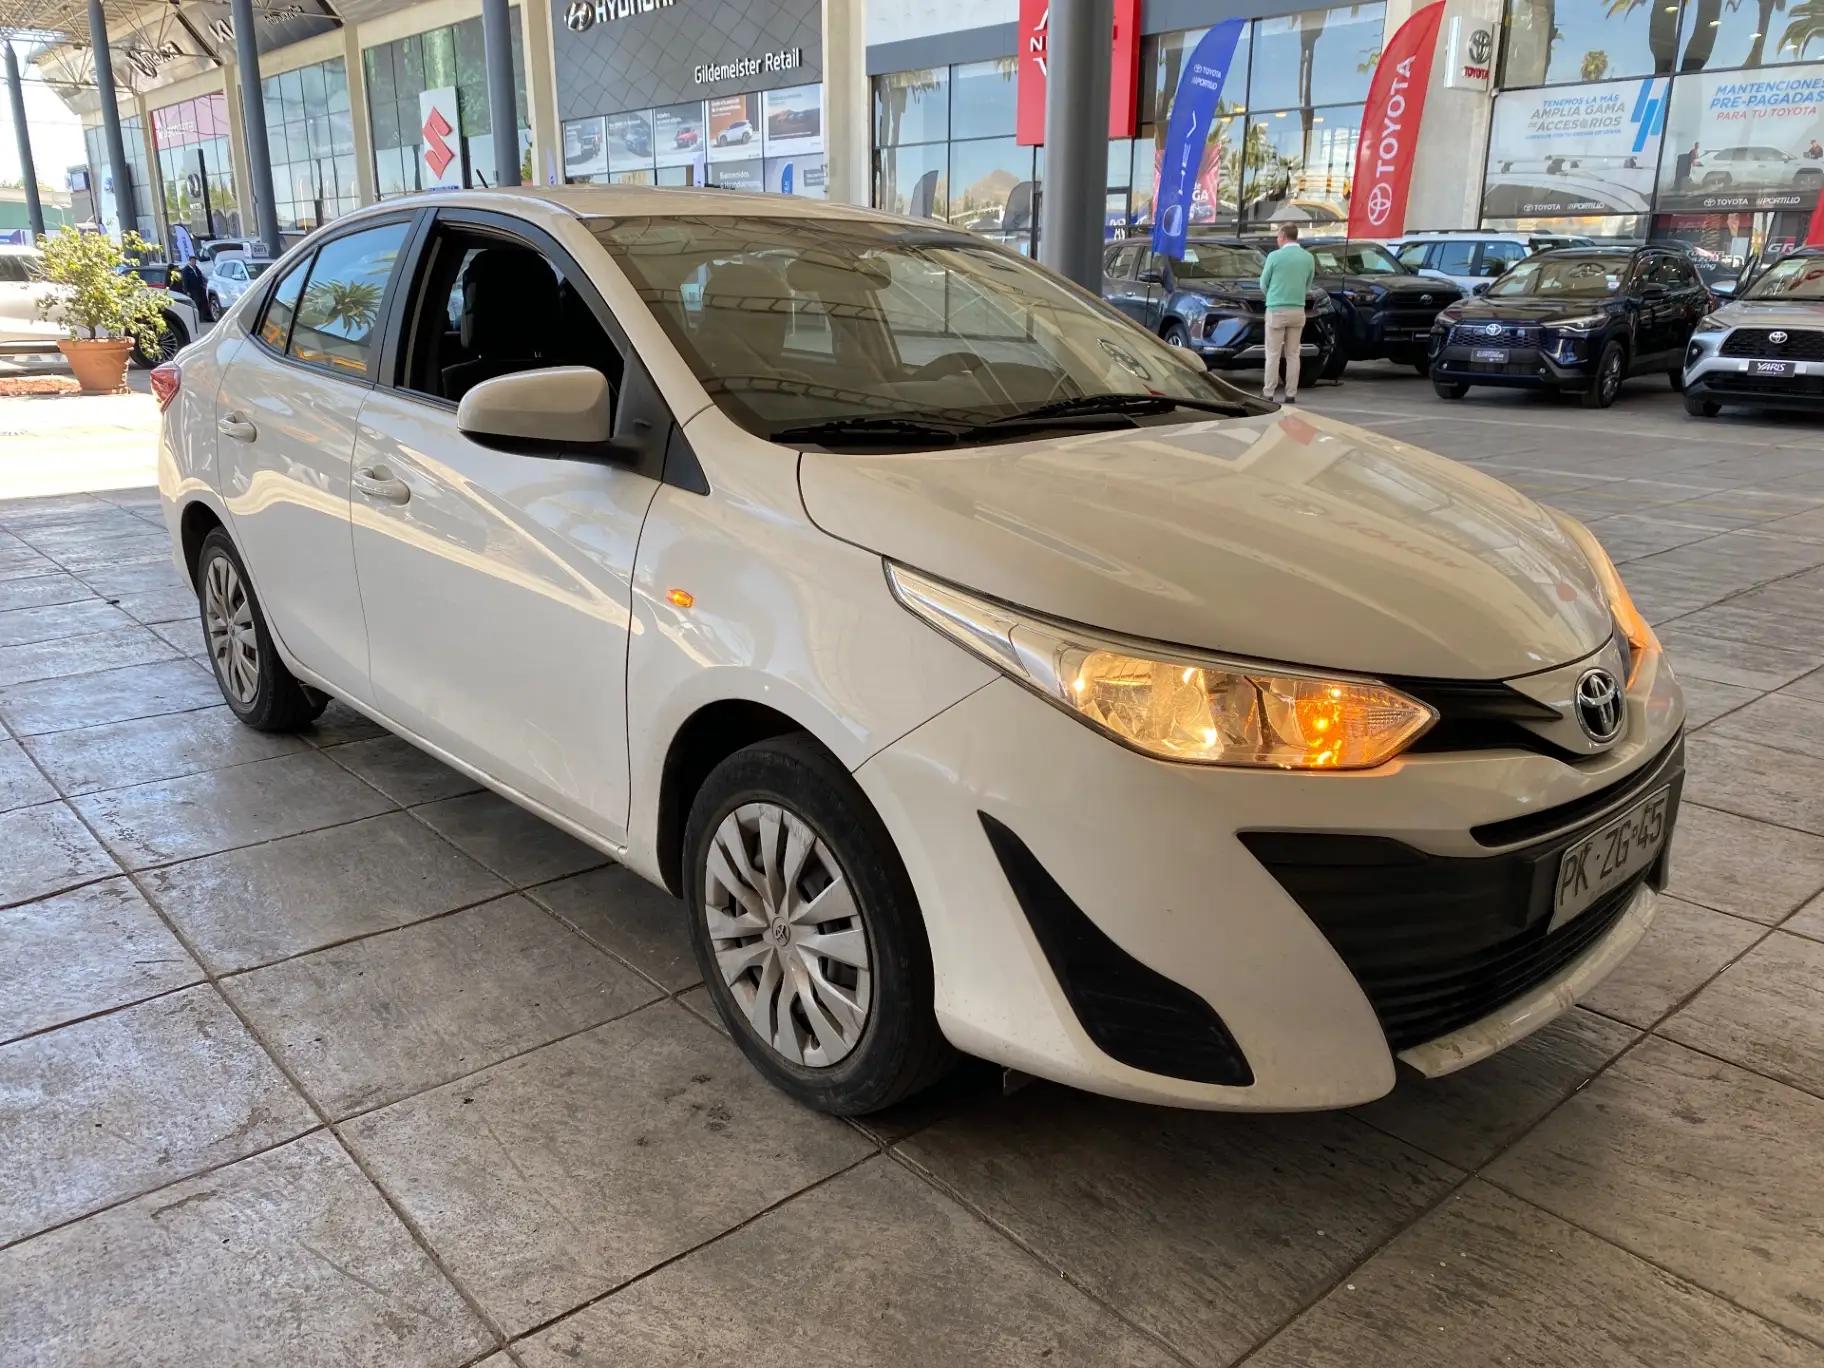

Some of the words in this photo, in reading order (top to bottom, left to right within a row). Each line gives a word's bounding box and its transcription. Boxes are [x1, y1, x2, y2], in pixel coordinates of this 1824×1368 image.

[695, 57, 762, 84] Gildemeister
[765, 48, 801, 72] Retail
[1543, 99, 1583, 107] TENEMOS
[1376, 55, 1416, 178] TOYOTA
[1530, 107, 1580, 120] AMPLIA
[1585, 103, 1624, 115] GAMA
[1717, 111, 1747, 121] PARA
[1752, 109, 1768, 118] TU
[1770, 106, 1817, 117] TOYOTA
[1717, 197, 1748, 206] TOYOTA
[1534, 204, 1561, 212] TOYOTA
[1757, 362, 1786, 372] YARIS
